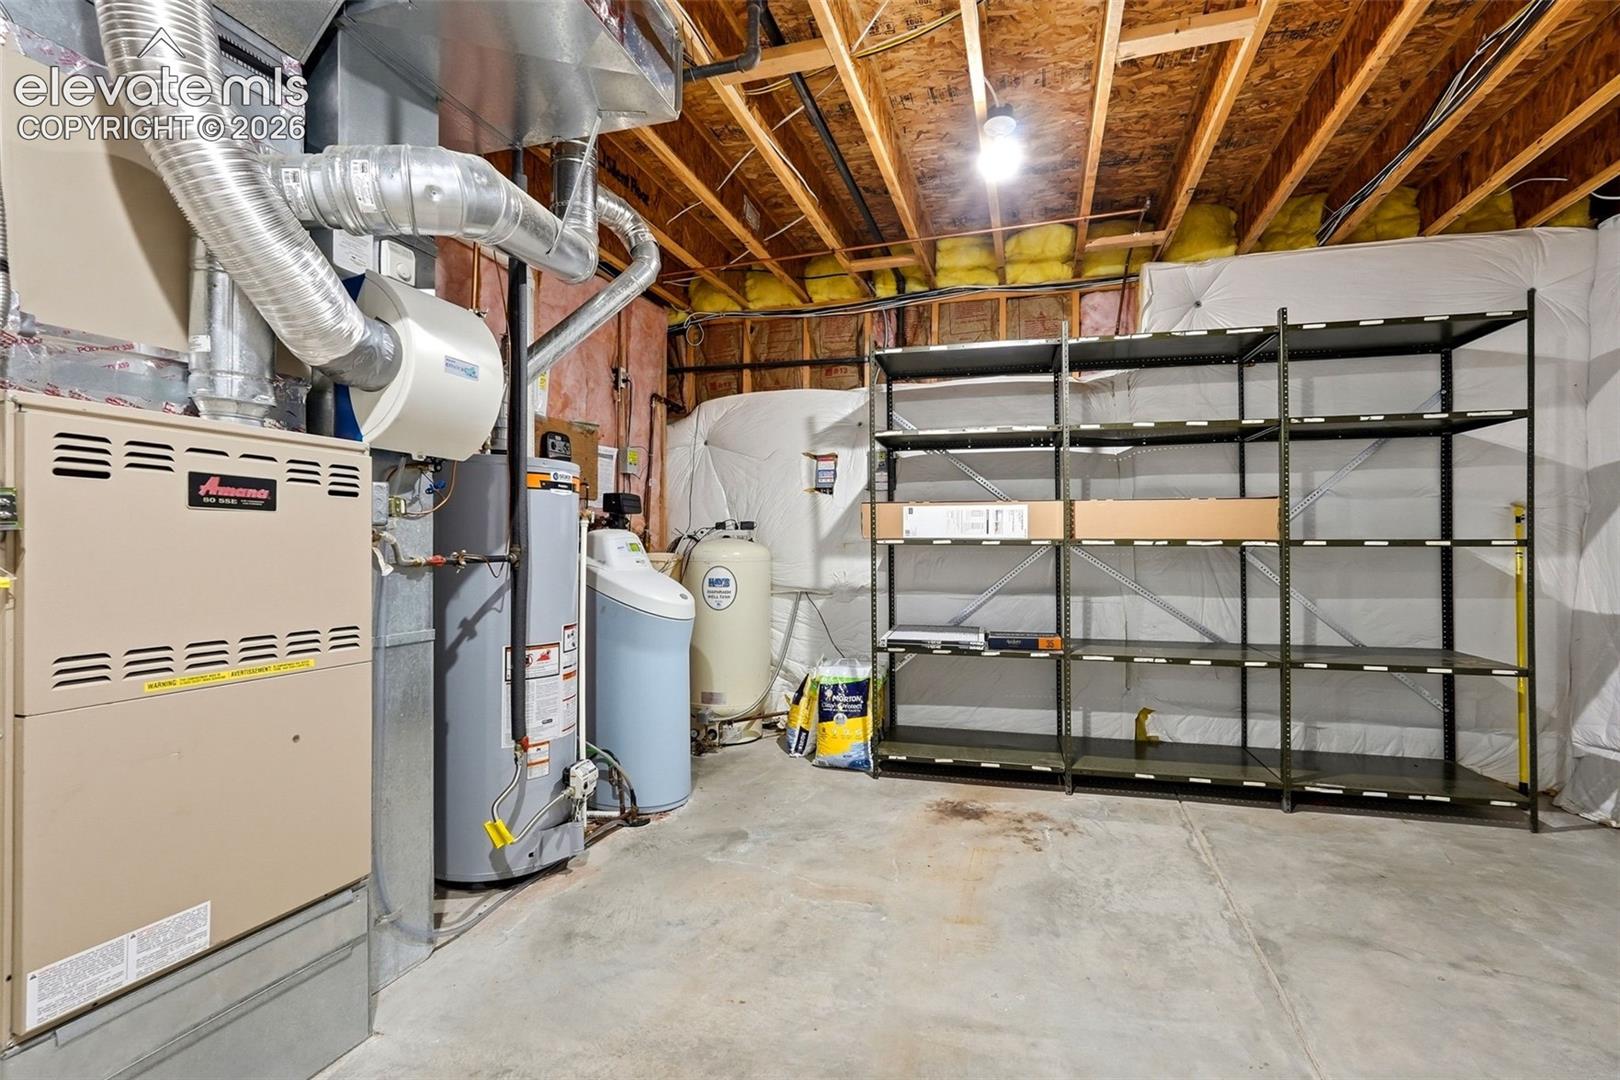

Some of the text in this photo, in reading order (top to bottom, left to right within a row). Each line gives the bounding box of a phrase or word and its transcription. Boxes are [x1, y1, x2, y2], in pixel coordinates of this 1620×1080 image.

[198, 476, 270, 499] Amana
[1045, 639, 1054, 648] 35
[832, 694, 862, 702] MORTON
